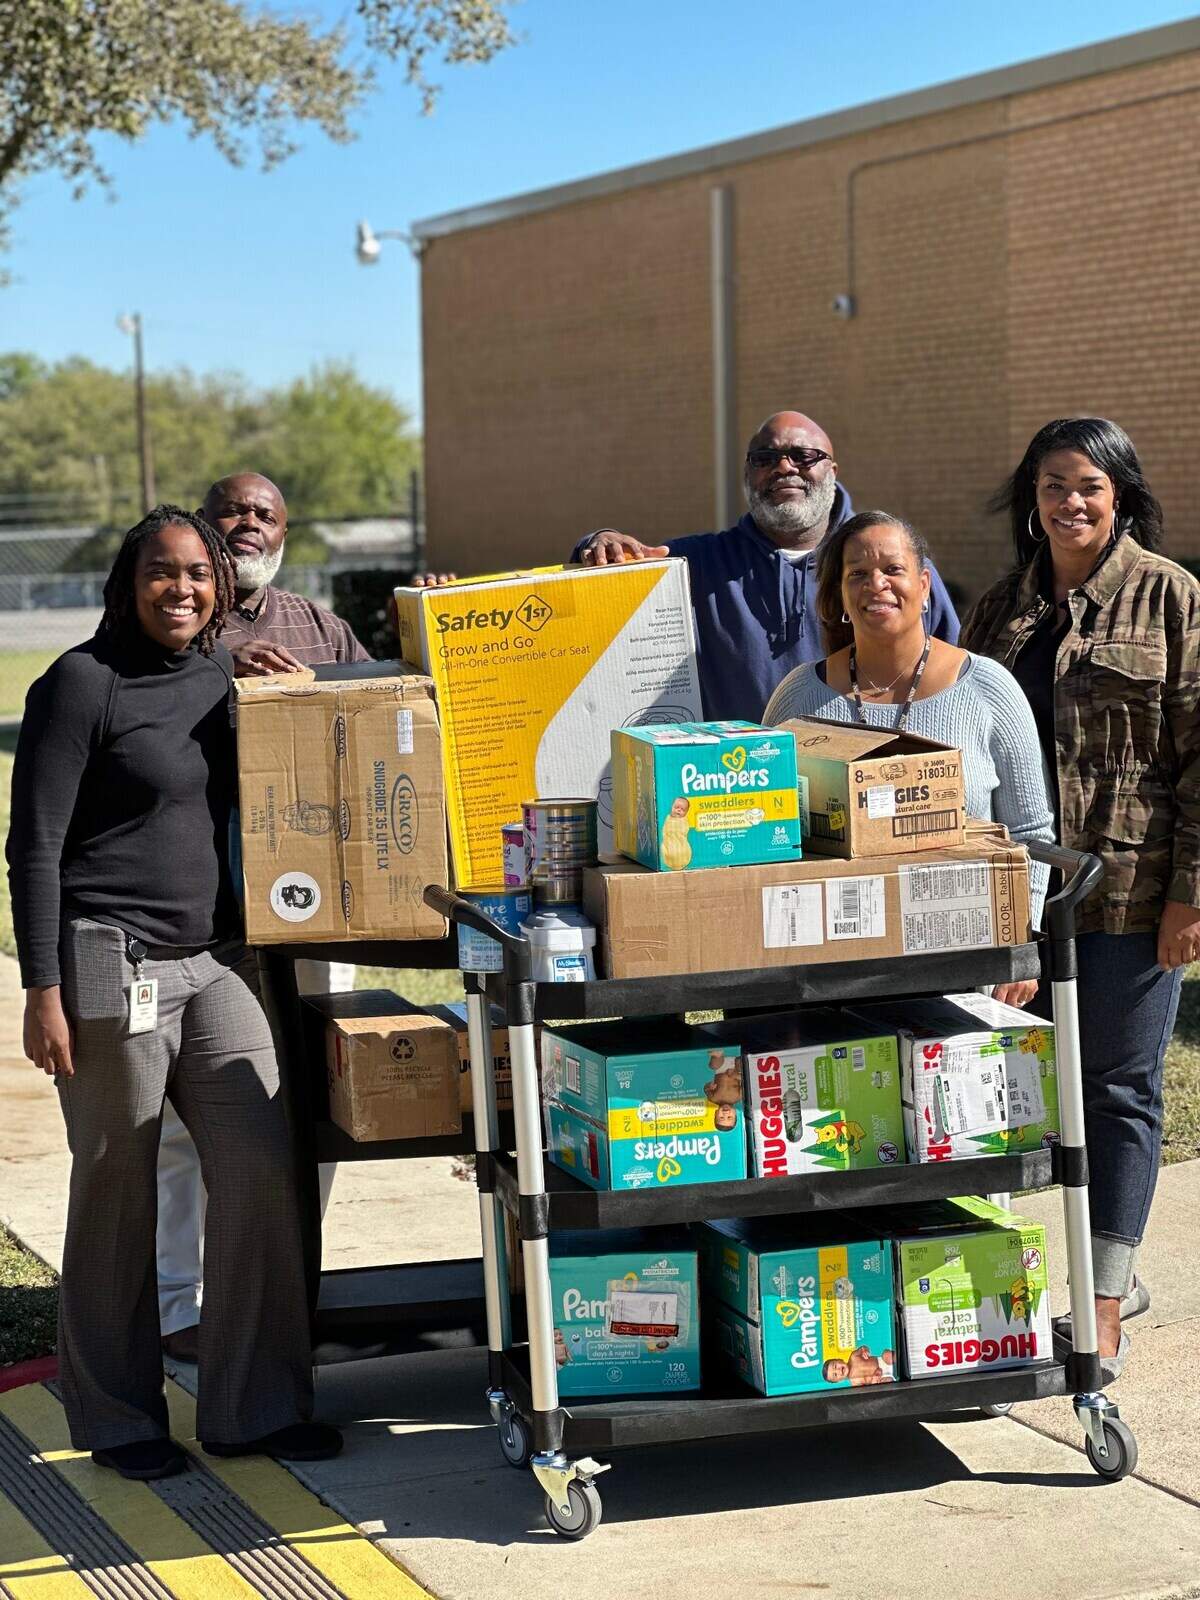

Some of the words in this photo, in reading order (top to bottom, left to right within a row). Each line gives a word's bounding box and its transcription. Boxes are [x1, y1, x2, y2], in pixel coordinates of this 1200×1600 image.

[436, 609, 514, 633] Safety
[439, 644, 478, 658] Grow
[482, 638, 509, 653] and
[440, 658, 489, 672] All-in-One
[491, 650, 547, 665] Convertible
[549, 647, 566, 658] Car
[569, 644, 590, 656] Seat
[681, 763, 770, 794] Pampers
[855, 769, 864, 783] 8
[373, 760, 387, 812] SNUGRIDE
[366, 787, 374, 812] INFANT
[699, 796, 756, 810] swaddlers
[773, 797, 784, 808] N
[858, 785, 930, 808] HGIES
[915, 802, 933, 812] care
[366, 813, 374, 826] CAR
[375, 817, 388, 830] 35
[399, 786, 413, 847] GRACO
[699, 821, 712, 829] skin
[713, 818, 745, 828] protection
[774, 826, 786, 835] 84
[376, 832, 389, 854] LITE
[377, 857, 389, 871] LX
[1000, 902, 1012, 943] COLOR:
[619, 1080, 631, 1089] 84
[799, 1072, 808, 1102] care
[882, 1071, 892, 1088] 768
[757, 1056, 788, 1178] HUGGIES
[623, 1120, 632, 1133] 2
[649, 1119, 705, 1132] swaddlers
[634, 1134, 721, 1165] Pampers
[944, 1245, 961, 1256] 768
[826, 1264, 834, 1272] 2
[863, 1258, 871, 1270] 84
[994, 1267, 1008, 1278] NOT
[790, 1275, 821, 1369] Pampers
[825, 1290, 834, 1349] swaddlers
[845, 1300, 853, 1333] protection
[943, 1312, 972, 1325] care
[934, 1322, 982, 1341] natural
[592, 1351, 608, 1359] days
[614, 1350, 634, 1358] nights
[924, 1332, 1038, 1368] HUGGIES
[665, 1371, 688, 1379] DIAPERS
[668, 1363, 685, 1372] 120
